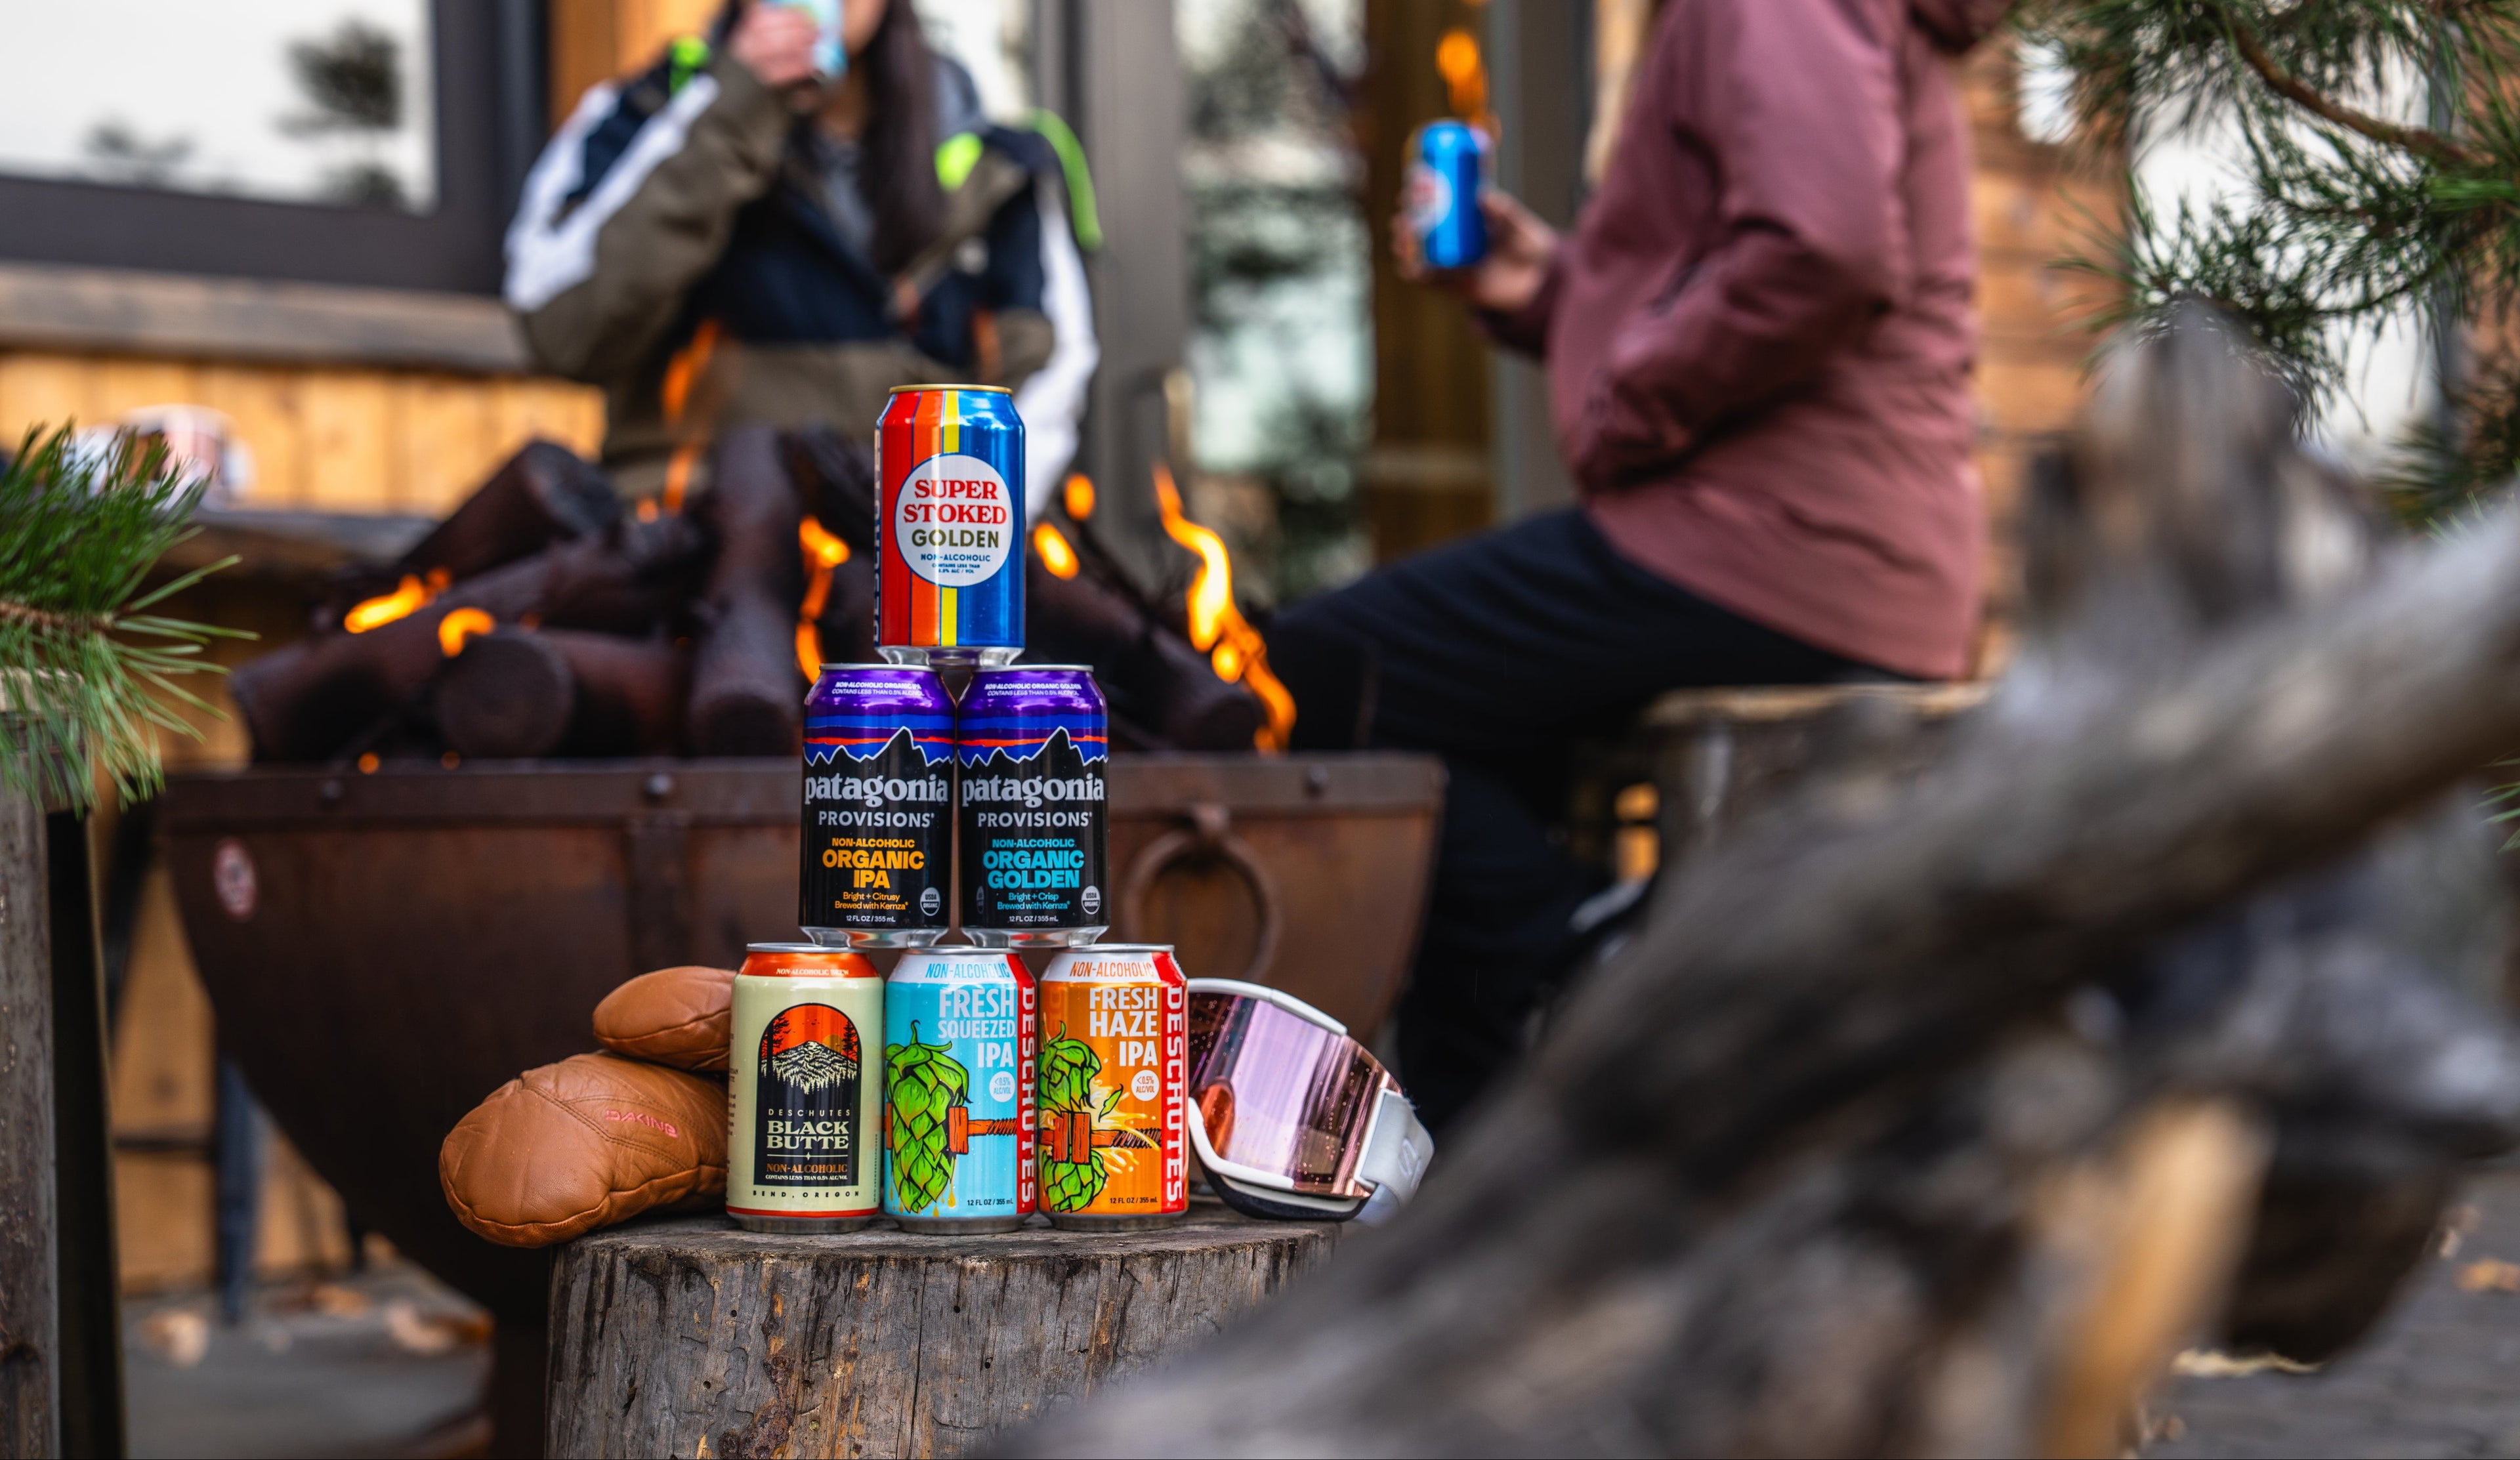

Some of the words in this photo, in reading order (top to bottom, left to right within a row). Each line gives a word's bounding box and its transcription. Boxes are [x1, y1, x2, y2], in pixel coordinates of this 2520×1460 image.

[914, 479, 998, 500] SUPER
[903, 503, 1007, 524] STOKED
[912, 528, 999, 548] GOLDEN
[921, 553, 991, 562] NON-ALCOHOLIC
[805, 772, 948, 808] patagonia
[961, 772, 1104, 808] patagonia
[831, 837, 915, 848] NON-ALCOHOLIC
[992, 839, 1076, 848] NON-ALCOHOLIC
[822, 848, 925, 870] ORGANIC
[982, 850, 1084, 870] ORGANIC
[853, 869, 891, 889] IPA
[987, 869, 1080, 889] GOLDEN
[835, 900, 862, 909] Brewed
[863, 901, 879, 909] with
[843, 891, 865, 902] Bright
[872, 892, 900, 902] Citrusy
[997, 902, 1025, 910] Brewed
[1025, 901, 1041, 909] with
[1008, 892, 1031, 902] Bright
[1038, 892, 1059, 902] Crisp
[925, 963, 1010, 978] NON-ALCOHOLIC
[1070, 961, 1154, 977] NON-ALCOHOLIC
[939, 988, 1015, 1018] FRESH
[1089, 987, 1158, 1010] FRESH
[977, 1042, 1014, 1068] IPA
[1119, 1041, 1158, 1066] IPA
[768, 1108, 850, 1117] DESCHUTES
[605, 1110, 679, 1139] DAKINE
[767, 1120, 850, 1135] BLACK
[766, 1135, 849, 1150] BUTTE
[766, 1163, 848, 1173] NON-ALCOHOLIC
